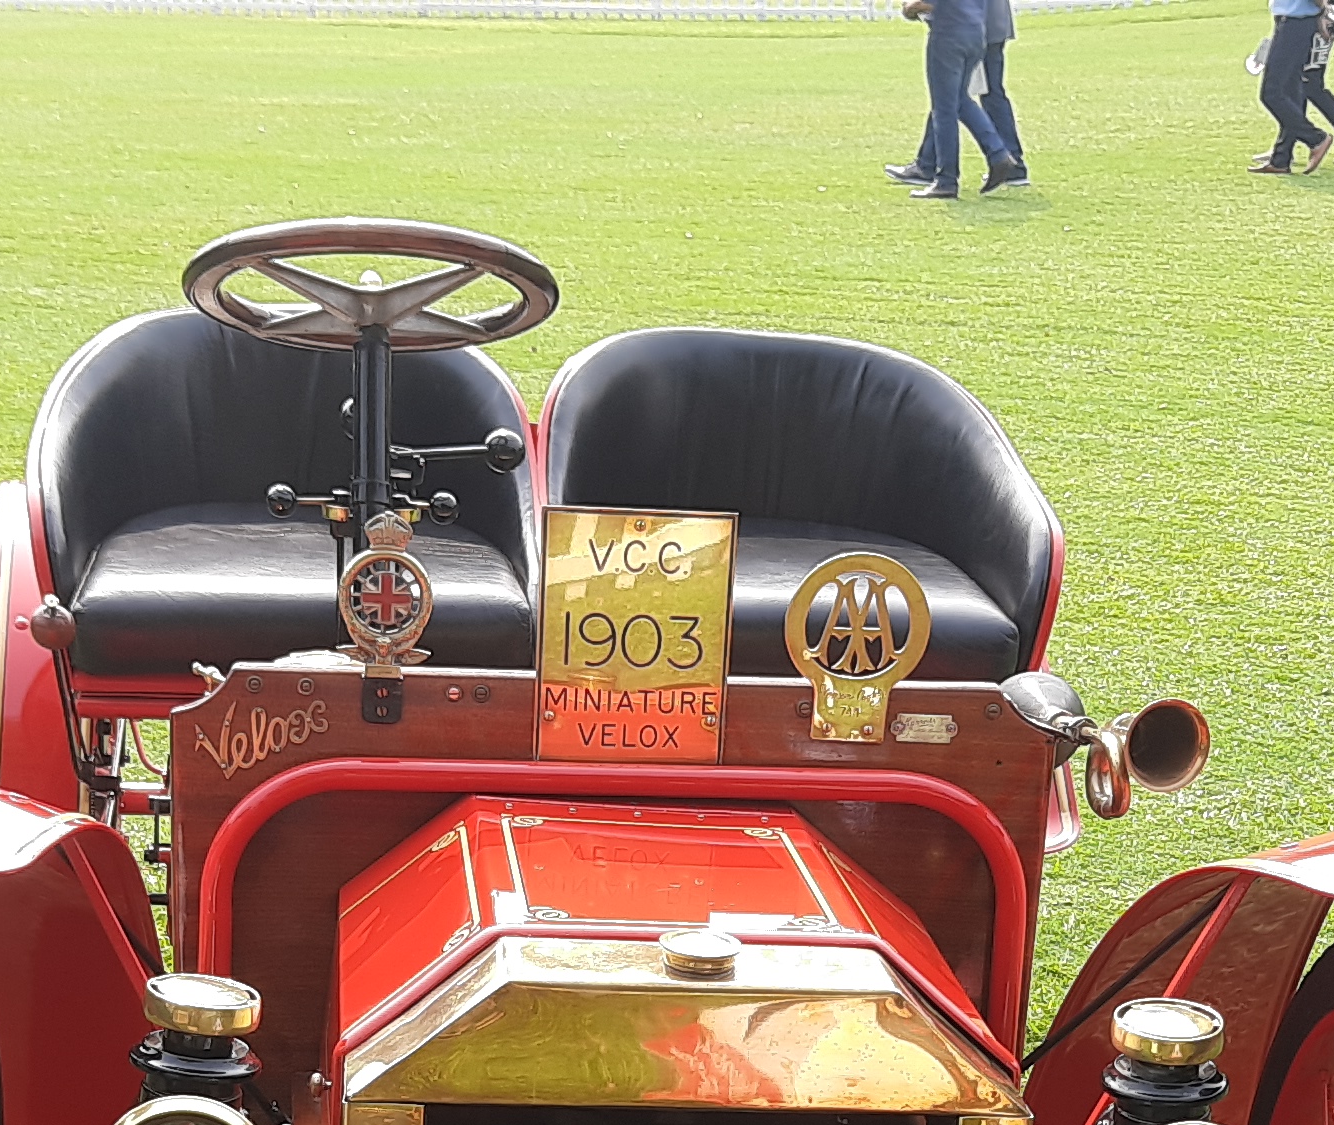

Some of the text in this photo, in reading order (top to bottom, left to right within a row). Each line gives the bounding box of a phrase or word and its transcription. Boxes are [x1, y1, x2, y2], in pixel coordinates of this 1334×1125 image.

[588, 538, 689, 575] V.C.C.
[563, 611, 704, 670] 1903
[544, 687, 718, 715] MINIATURE
[194, 700, 330, 779] Velox
[578, 723, 681, 748] VELOX
